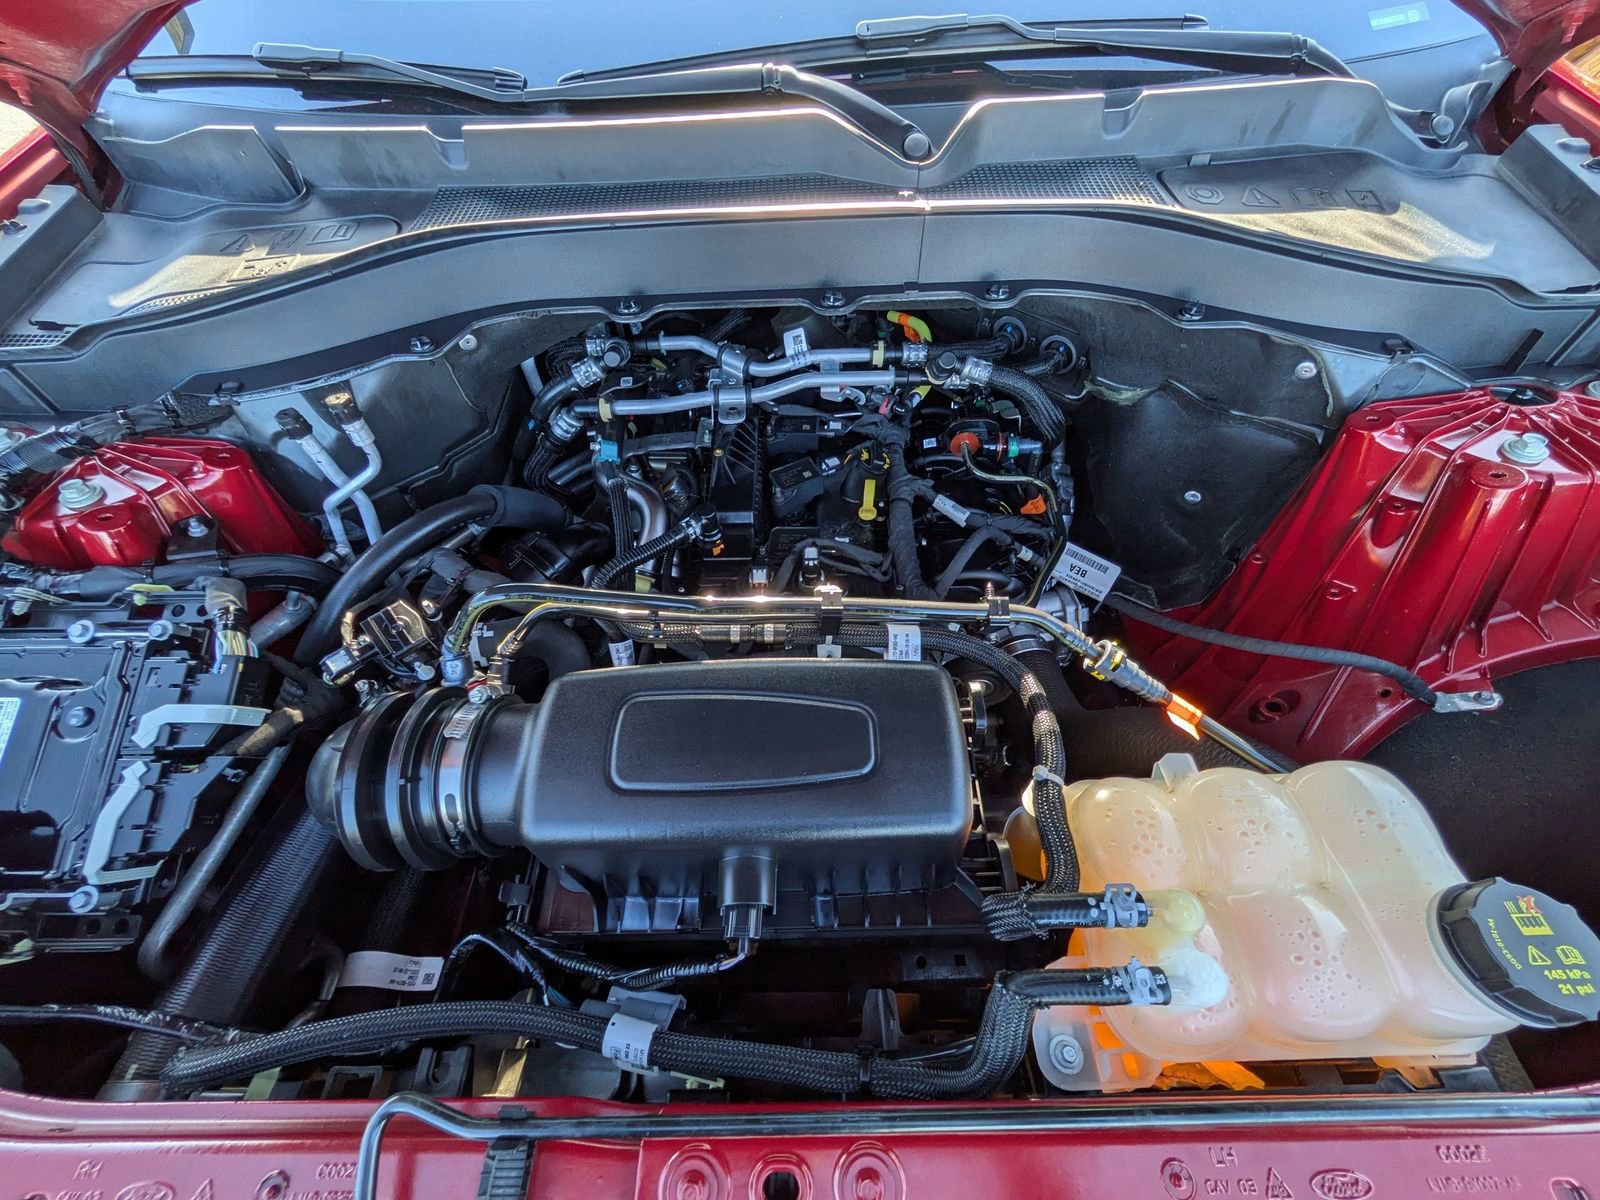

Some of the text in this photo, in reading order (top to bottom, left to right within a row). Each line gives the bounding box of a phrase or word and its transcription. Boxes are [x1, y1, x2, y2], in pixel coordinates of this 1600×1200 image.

[1069, 562, 1088, 578] BEA
[1543, 968, 1592, 981] 145 kPa
[1557, 983, 1596, 997] 21 psi
[1208, 1146, 1238, 1167] LH
[1204, 1178, 1231, 1196] CAV
